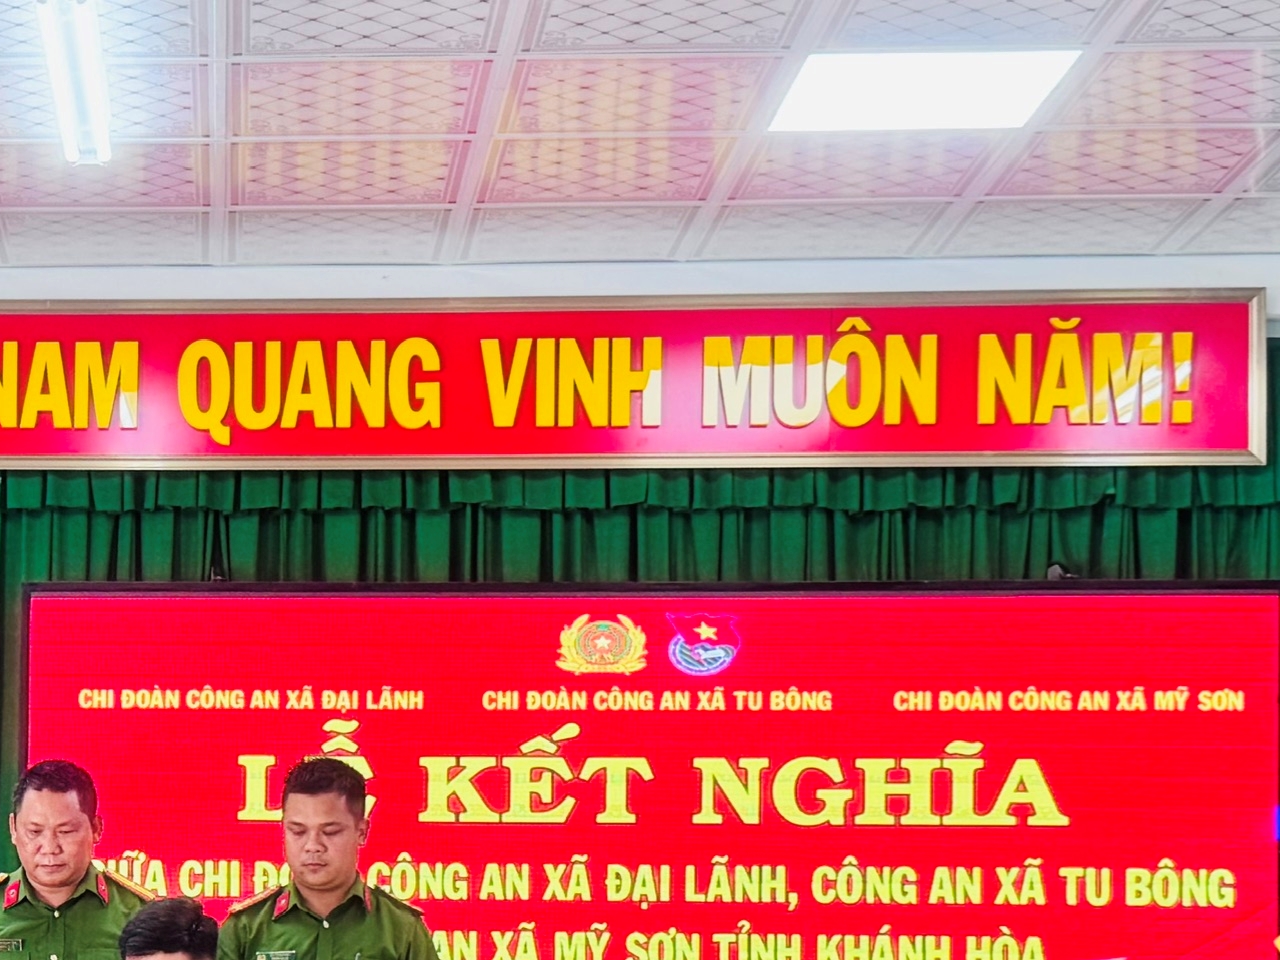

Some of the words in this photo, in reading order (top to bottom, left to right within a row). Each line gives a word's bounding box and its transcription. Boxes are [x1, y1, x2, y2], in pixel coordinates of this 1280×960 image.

[176, 336, 440, 447] QUANG
[480, 336, 663, 430] VINH
[702, 316, 939, 429] MUÔN
[976, 317, 1196, 427] NĂM!
[78, 688, 115, 710] CHI
[120, 685, 180, 710] ĐOÀN
[185, 684, 245, 710] CÔNG
[250, 689, 280, 710] AN
[285, 685, 314, 710] XÃ
[321, 689, 359, 714] ĐẠI
[366, 685, 424, 710] LÃNH
[482, 690, 519, 711] CHI
[526, 685, 588, 711] ĐOÀN
[593, 685, 654, 711] CÔNG
[659, 690, 691, 711] AN
[696, 686, 726, 711] XÃ
[732, 690, 763, 711] TU
[769, 686, 833, 711] BÔNG
[893, 690, 932, 711] CHI
[938, 686, 1003, 712] ĐOÀN
[1008, 685, 1073, 711] CÔNG
[1077, 690, 1110, 711] AN
[1115, 686, 1147, 711] XÃ
[1154, 685, 1190, 711] MỸ
[1197, 688, 1245, 712] SƠN
[418, 722, 655, 825] KẾT
[691, 740, 1071, 827] NGHĨA
[91, 849, 168, 897] ỮA
[179, 859, 242, 898] CHI
[367, 851, 469, 902] CÔNG
[479, 862, 530, 901] AN
[542, 853, 592, 902] XÃ
[604, 863, 671, 910] ĐẠI
[684, 855, 799, 911] LÃNH,
[811, 855, 918, 905] CÔNG
[928, 866, 982, 905] AN
[994, 857, 1046, 906] XÃ
[1058, 866, 1112, 907] TU
[1125, 857, 1236, 908] BÔNG
